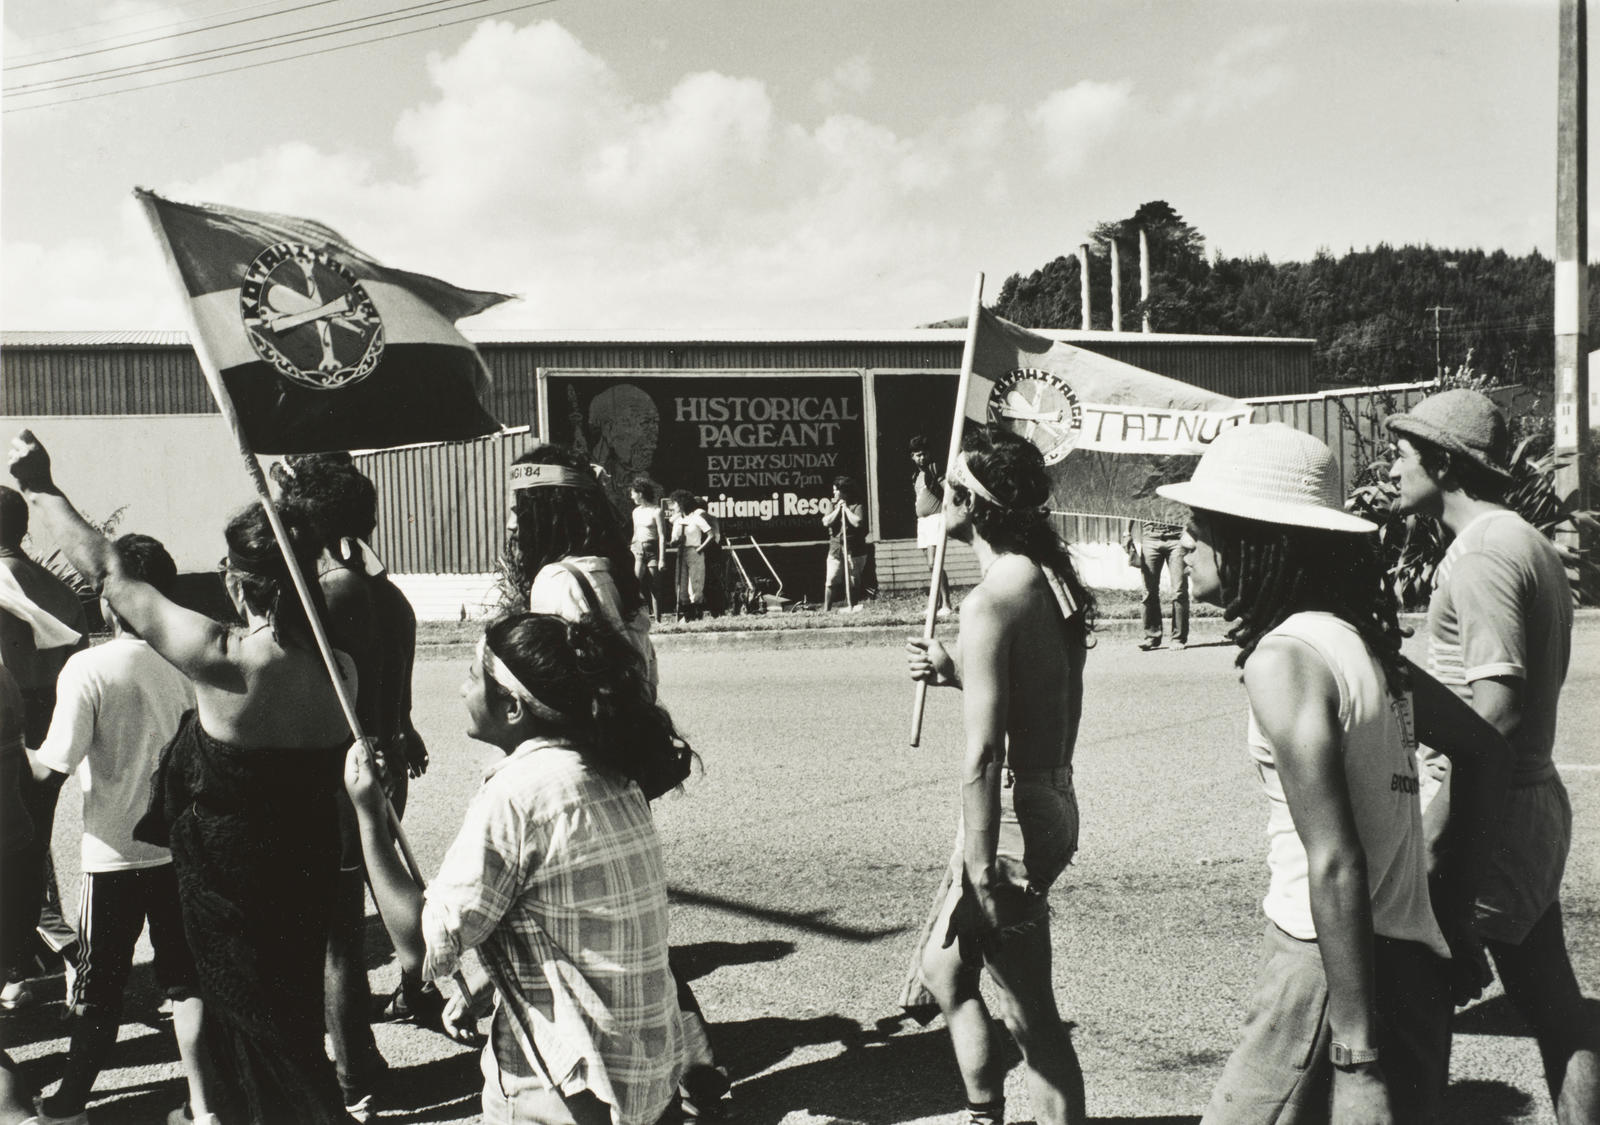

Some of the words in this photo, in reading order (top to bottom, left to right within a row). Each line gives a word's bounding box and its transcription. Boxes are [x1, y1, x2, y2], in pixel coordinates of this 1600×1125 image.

[674, 396, 858, 423] HISTORICAL
[698, 422, 840, 448] PAGEANT
[707, 454, 768, 471] EVERY
[769, 452, 838, 470] SUNDAY
[708, 471, 789, 488] EVENING
[791, 471, 823, 488] 7pm
[703, 492, 779, 521] aitangi
[784, 492, 833, 516] Reso
